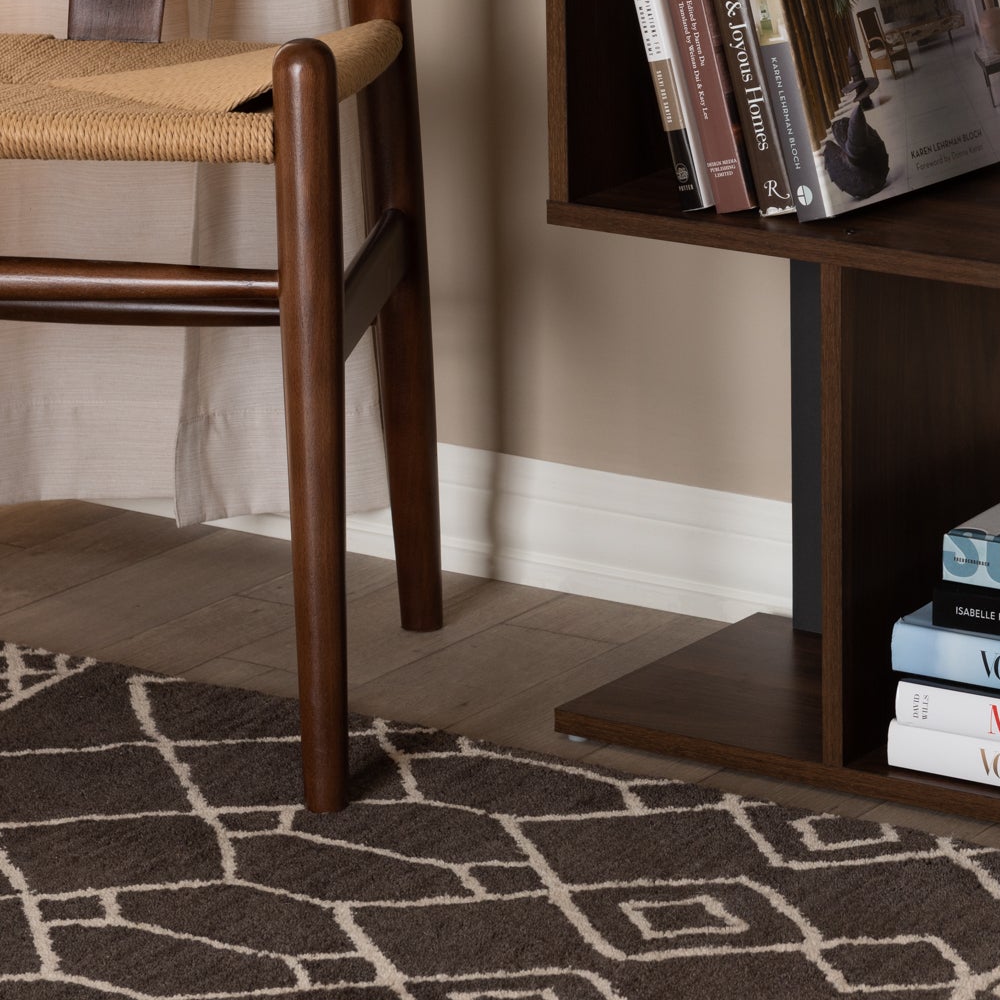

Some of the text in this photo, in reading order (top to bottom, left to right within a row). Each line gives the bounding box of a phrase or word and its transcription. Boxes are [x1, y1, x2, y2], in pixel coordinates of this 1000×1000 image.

[678, 1, 691, 34] Translated
[686, 0, 696, 22] Edited
[691, 22, 697, 30] by
[725, 1, 741, 17] &
[728, 20, 752, 83] Joyous
[745, 86, 769, 151] Homes
[771, 57, 801, 170] KAREN LEHRMAN BLOCH
[910, 145, 933, 159] KAREN
[763, 179, 791, 200] R
[955, 606, 996, 621] ISABELLE
[912, 693, 920, 719] DAVID
[921, 694, 929, 720] WILLS
